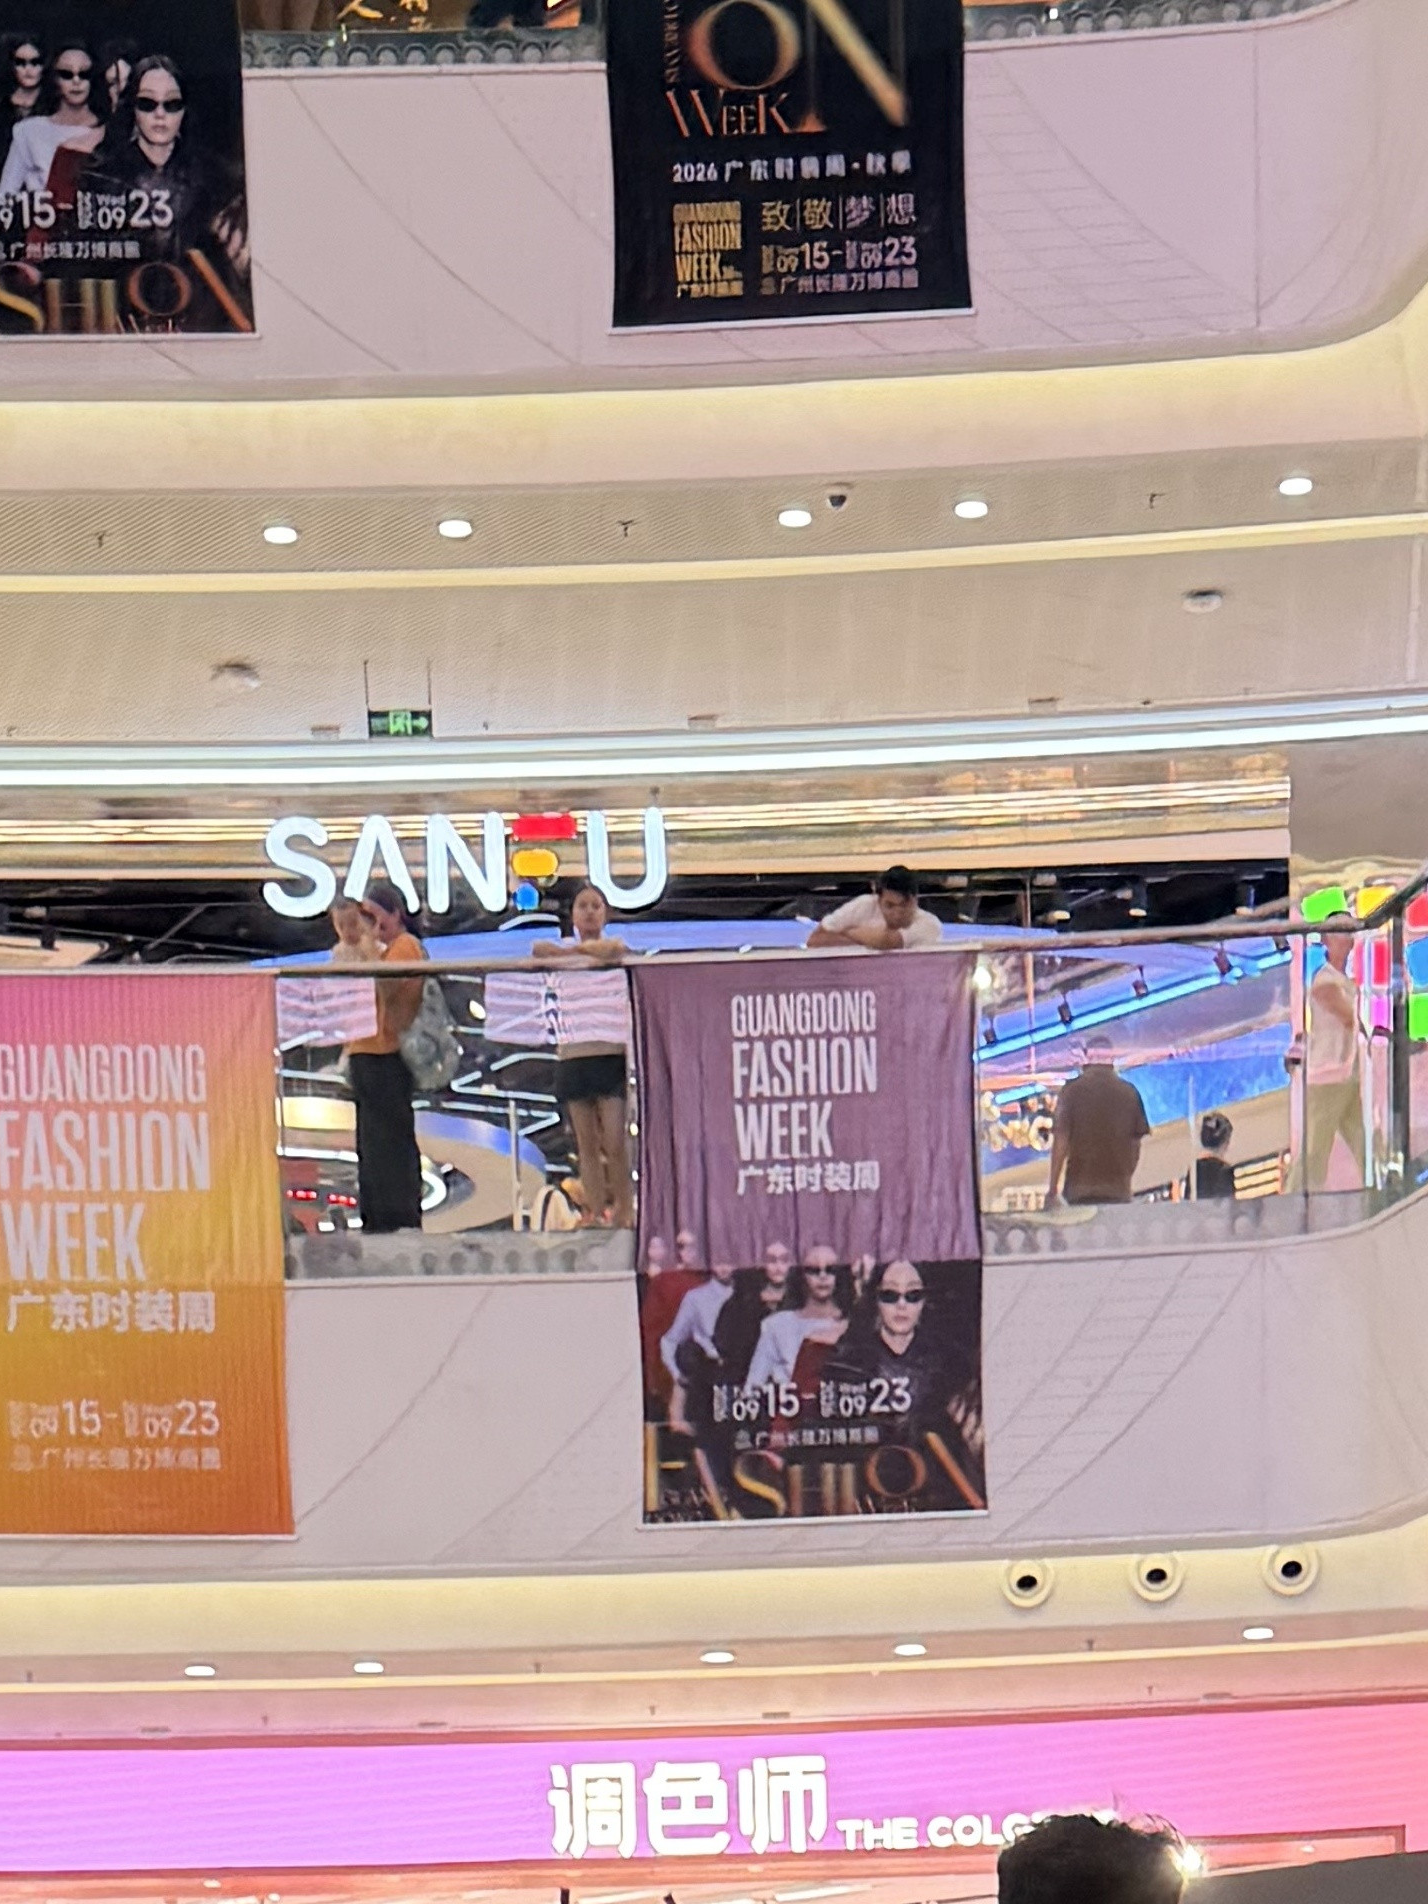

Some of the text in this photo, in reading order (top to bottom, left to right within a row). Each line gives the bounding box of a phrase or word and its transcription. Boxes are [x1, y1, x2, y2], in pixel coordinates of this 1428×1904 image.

[16, 189, 56, 229] 15
[129, 189, 173, 228] 23
[801, 240, 831, 271] 15
[884, 235, 918, 267] 23
[731, 991, 877, 1038] GUANGDONG
[733, 1036, 878, 1099] FASHION
[735, 1101, 833, 1161] WEEK
[737, 1161, 881, 1195] 广东时装周
[0, 1202, 148, 1283] WEEK
[6, 1289, 216, 1335] 广东时装周
[63, 1398, 101, 1437] 15
[175, 1398, 220, 1437] 23
[764, 1381, 800, 1417] 15
[870, 1376, 913, 1412] 23
[546, 1754, 828, 1860] 调色师
[835, 1816, 920, 1851] THE
